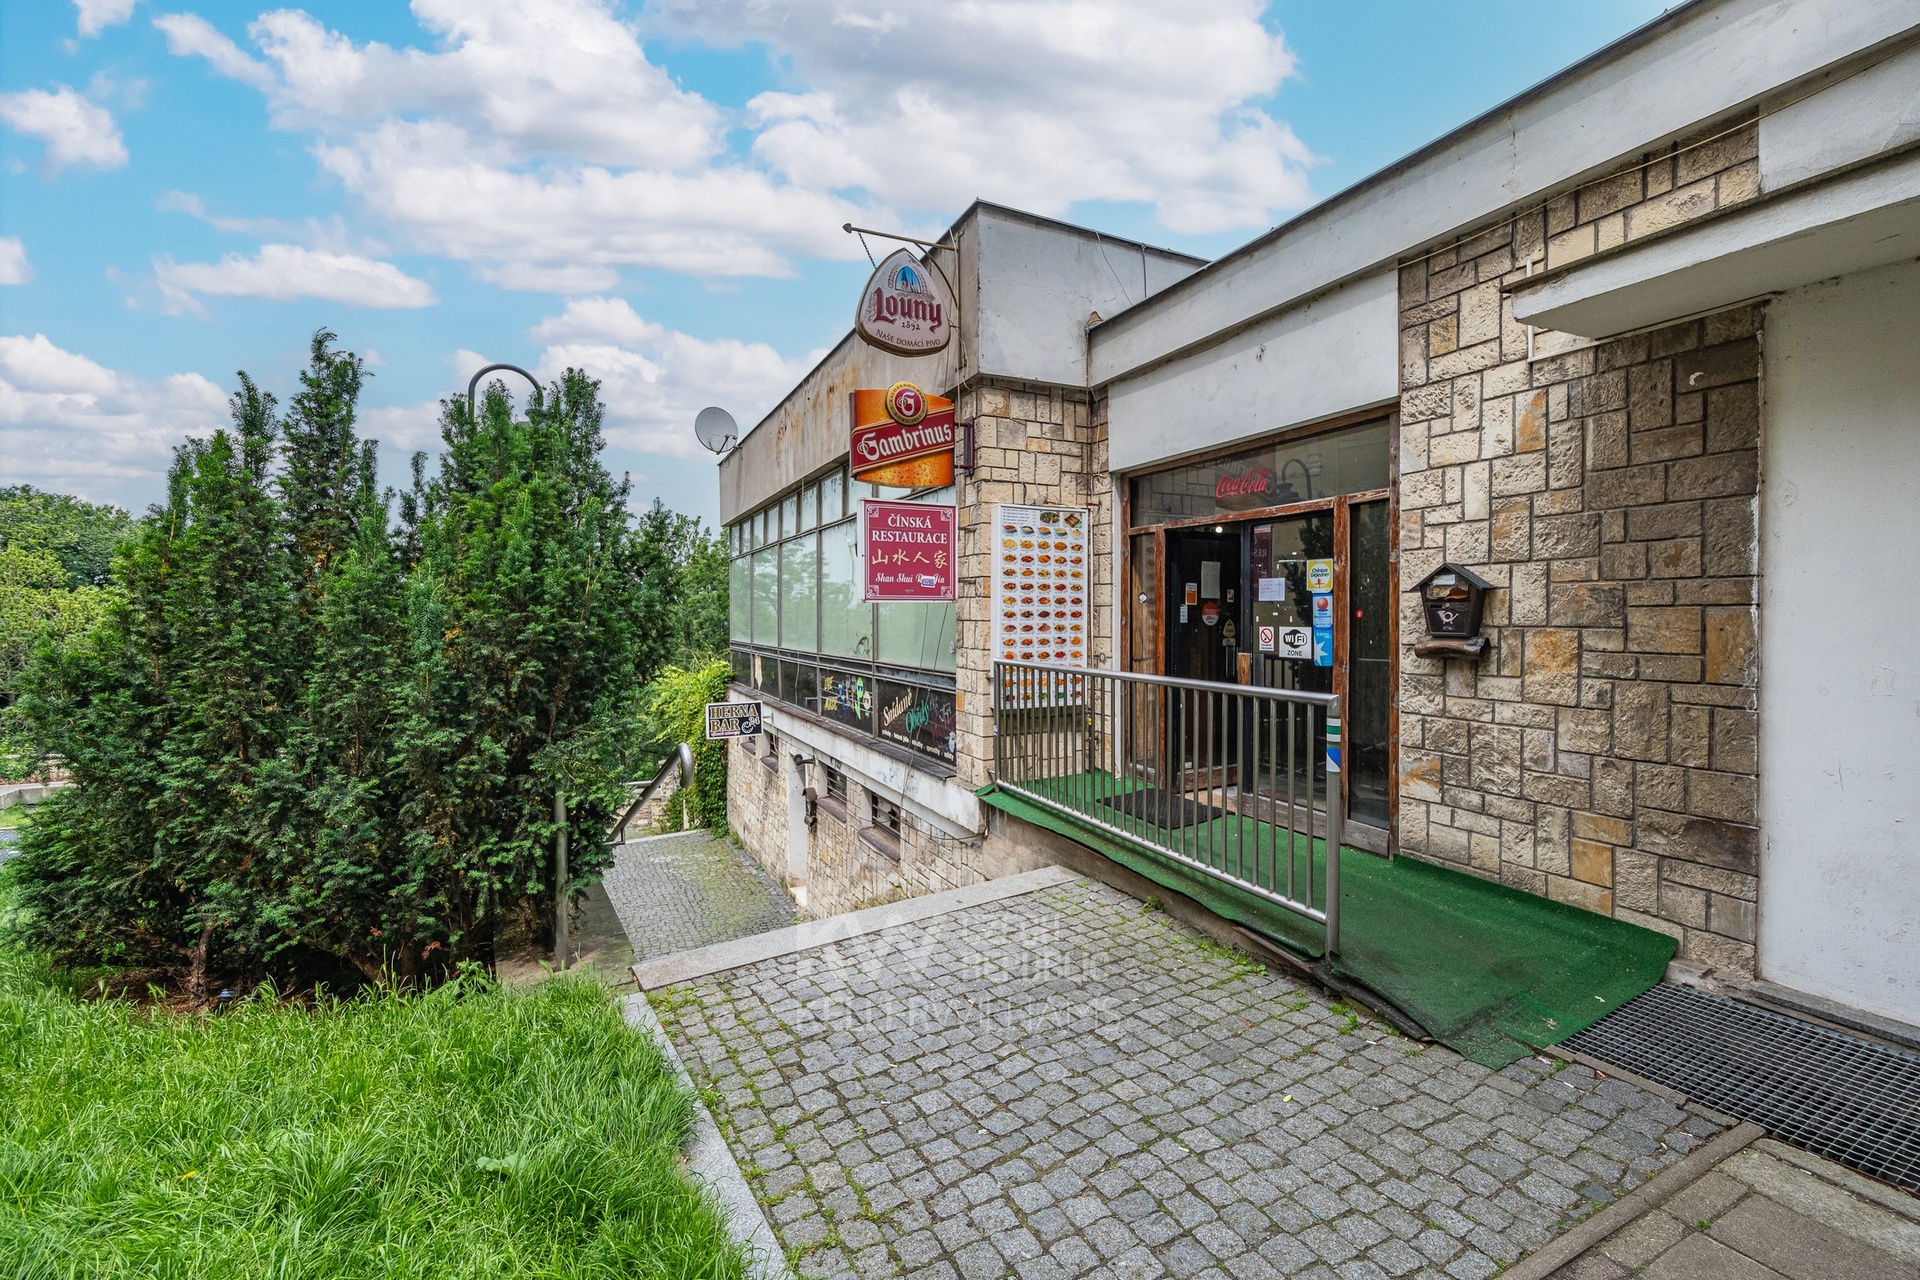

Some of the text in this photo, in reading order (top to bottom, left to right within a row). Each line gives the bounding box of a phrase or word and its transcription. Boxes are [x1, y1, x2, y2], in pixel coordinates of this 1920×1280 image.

[873, 287, 942, 334] Louny
[901, 321, 921, 331] 1892
[876, 329, 941, 347] NAŠE DOMÁCÍ PIVO
[857, 423, 952, 461] Gambrinus
[887, 513, 932, 529] ČÍNSKÁ
[871, 530, 948, 544] RESTAURACE
[871, 548, 948, 569] 山水人家
[710, 703, 759, 719] HERNA
[710, 719, 741, 732] BAR
